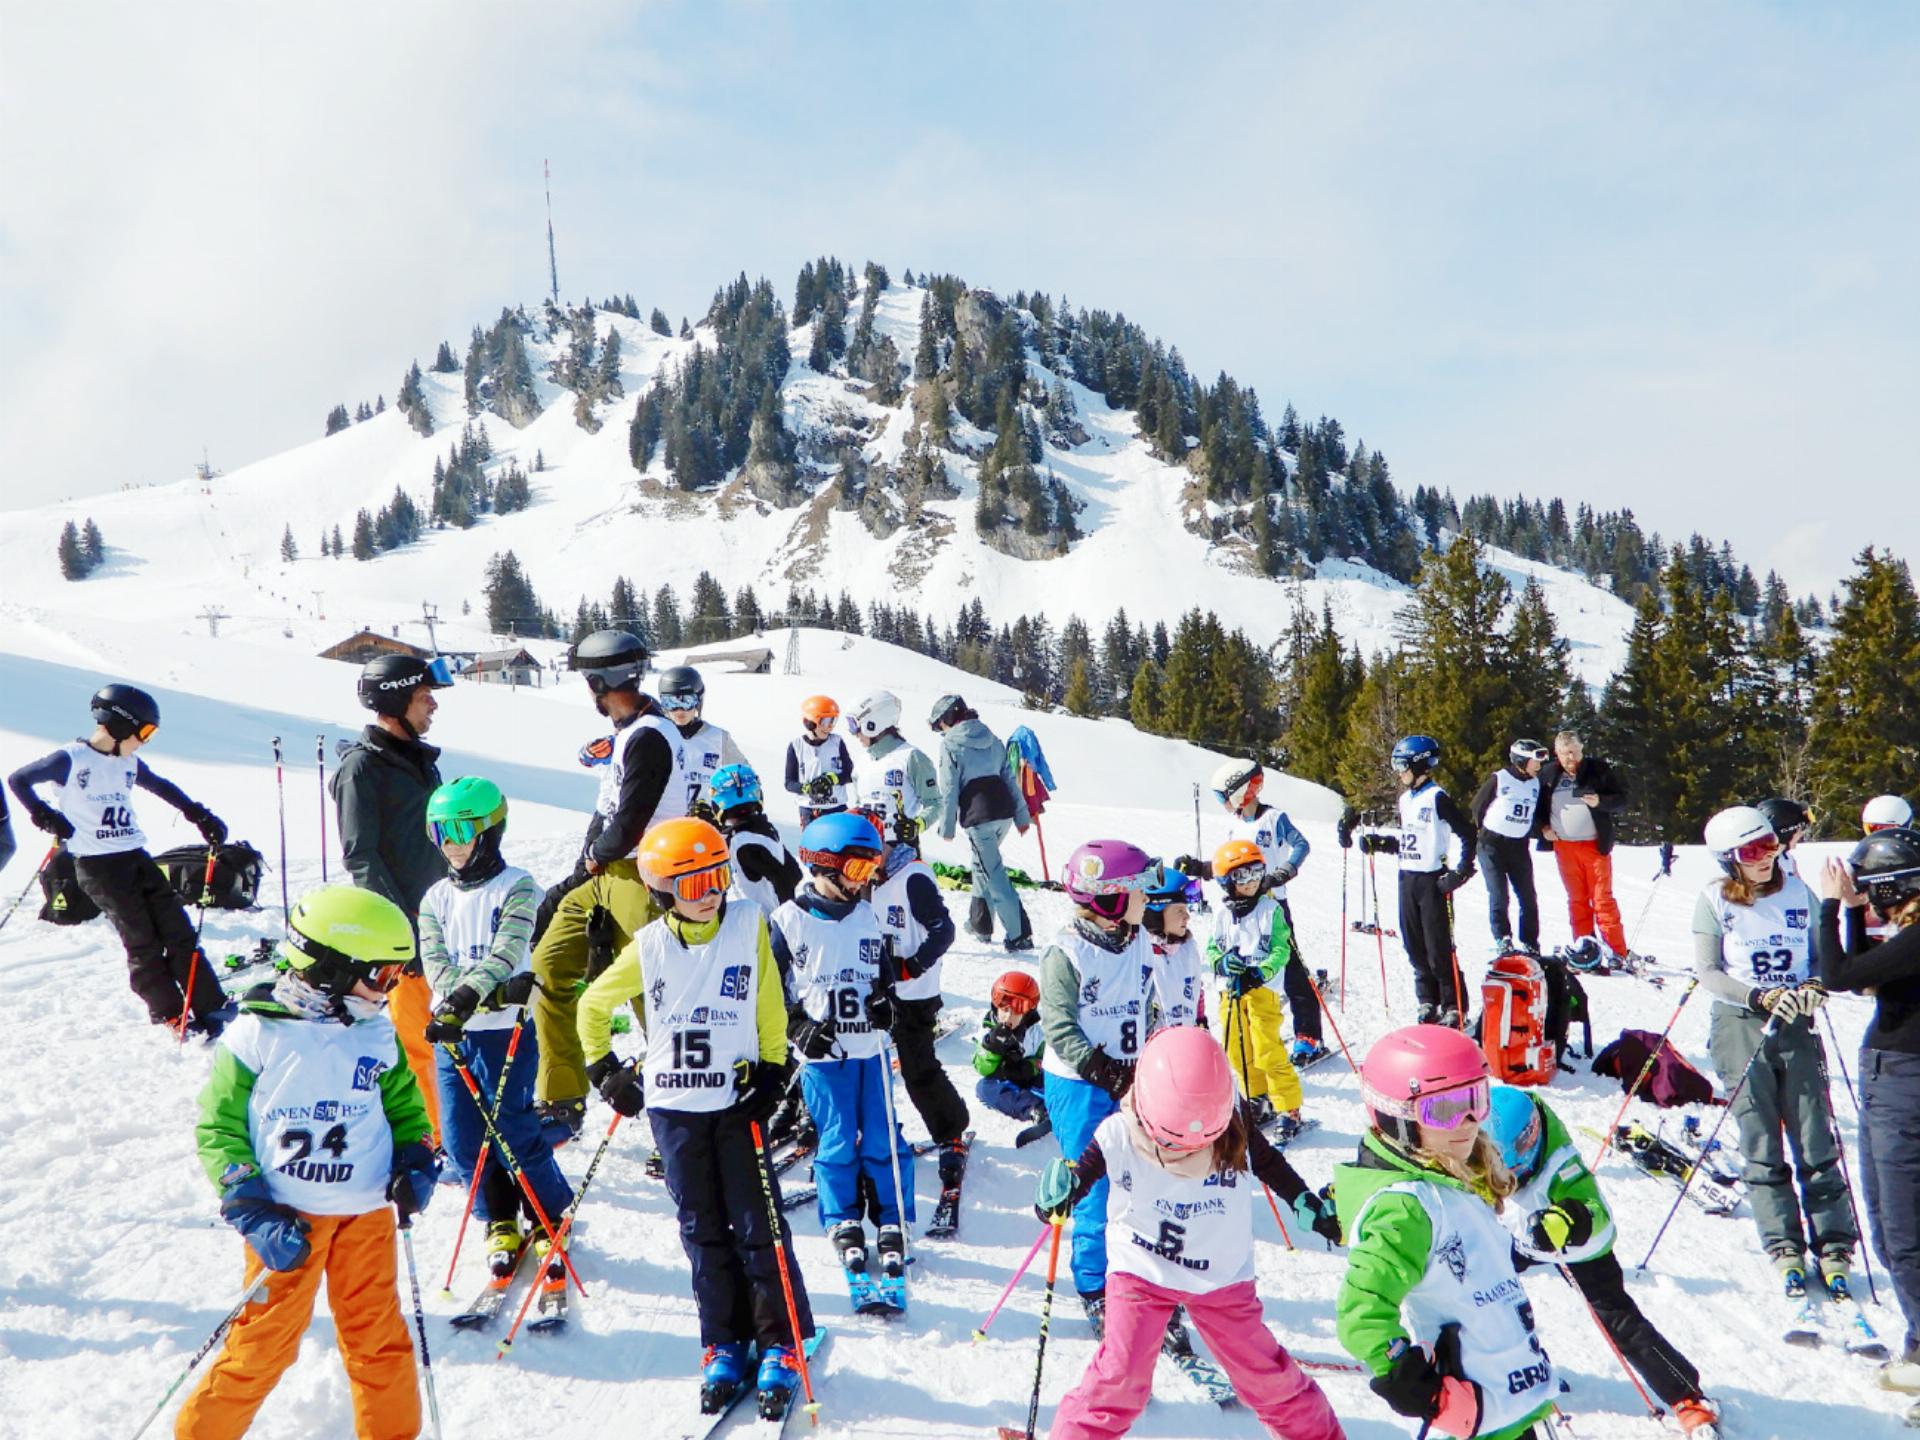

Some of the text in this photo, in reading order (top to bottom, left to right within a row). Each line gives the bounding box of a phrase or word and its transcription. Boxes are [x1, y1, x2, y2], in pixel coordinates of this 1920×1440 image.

[1513, 804, 1530, 818] 81
[1751, 949, 1793, 975] 63
[722, 973, 749, 996] SB
[828, 987, 860, 1019] 16
[672, 1029, 713, 1070] 15
[1120, 1020, 1138, 1055] 8
[655, 1071, 726, 1089] GRUND
[280, 1122, 350, 1160] 24
